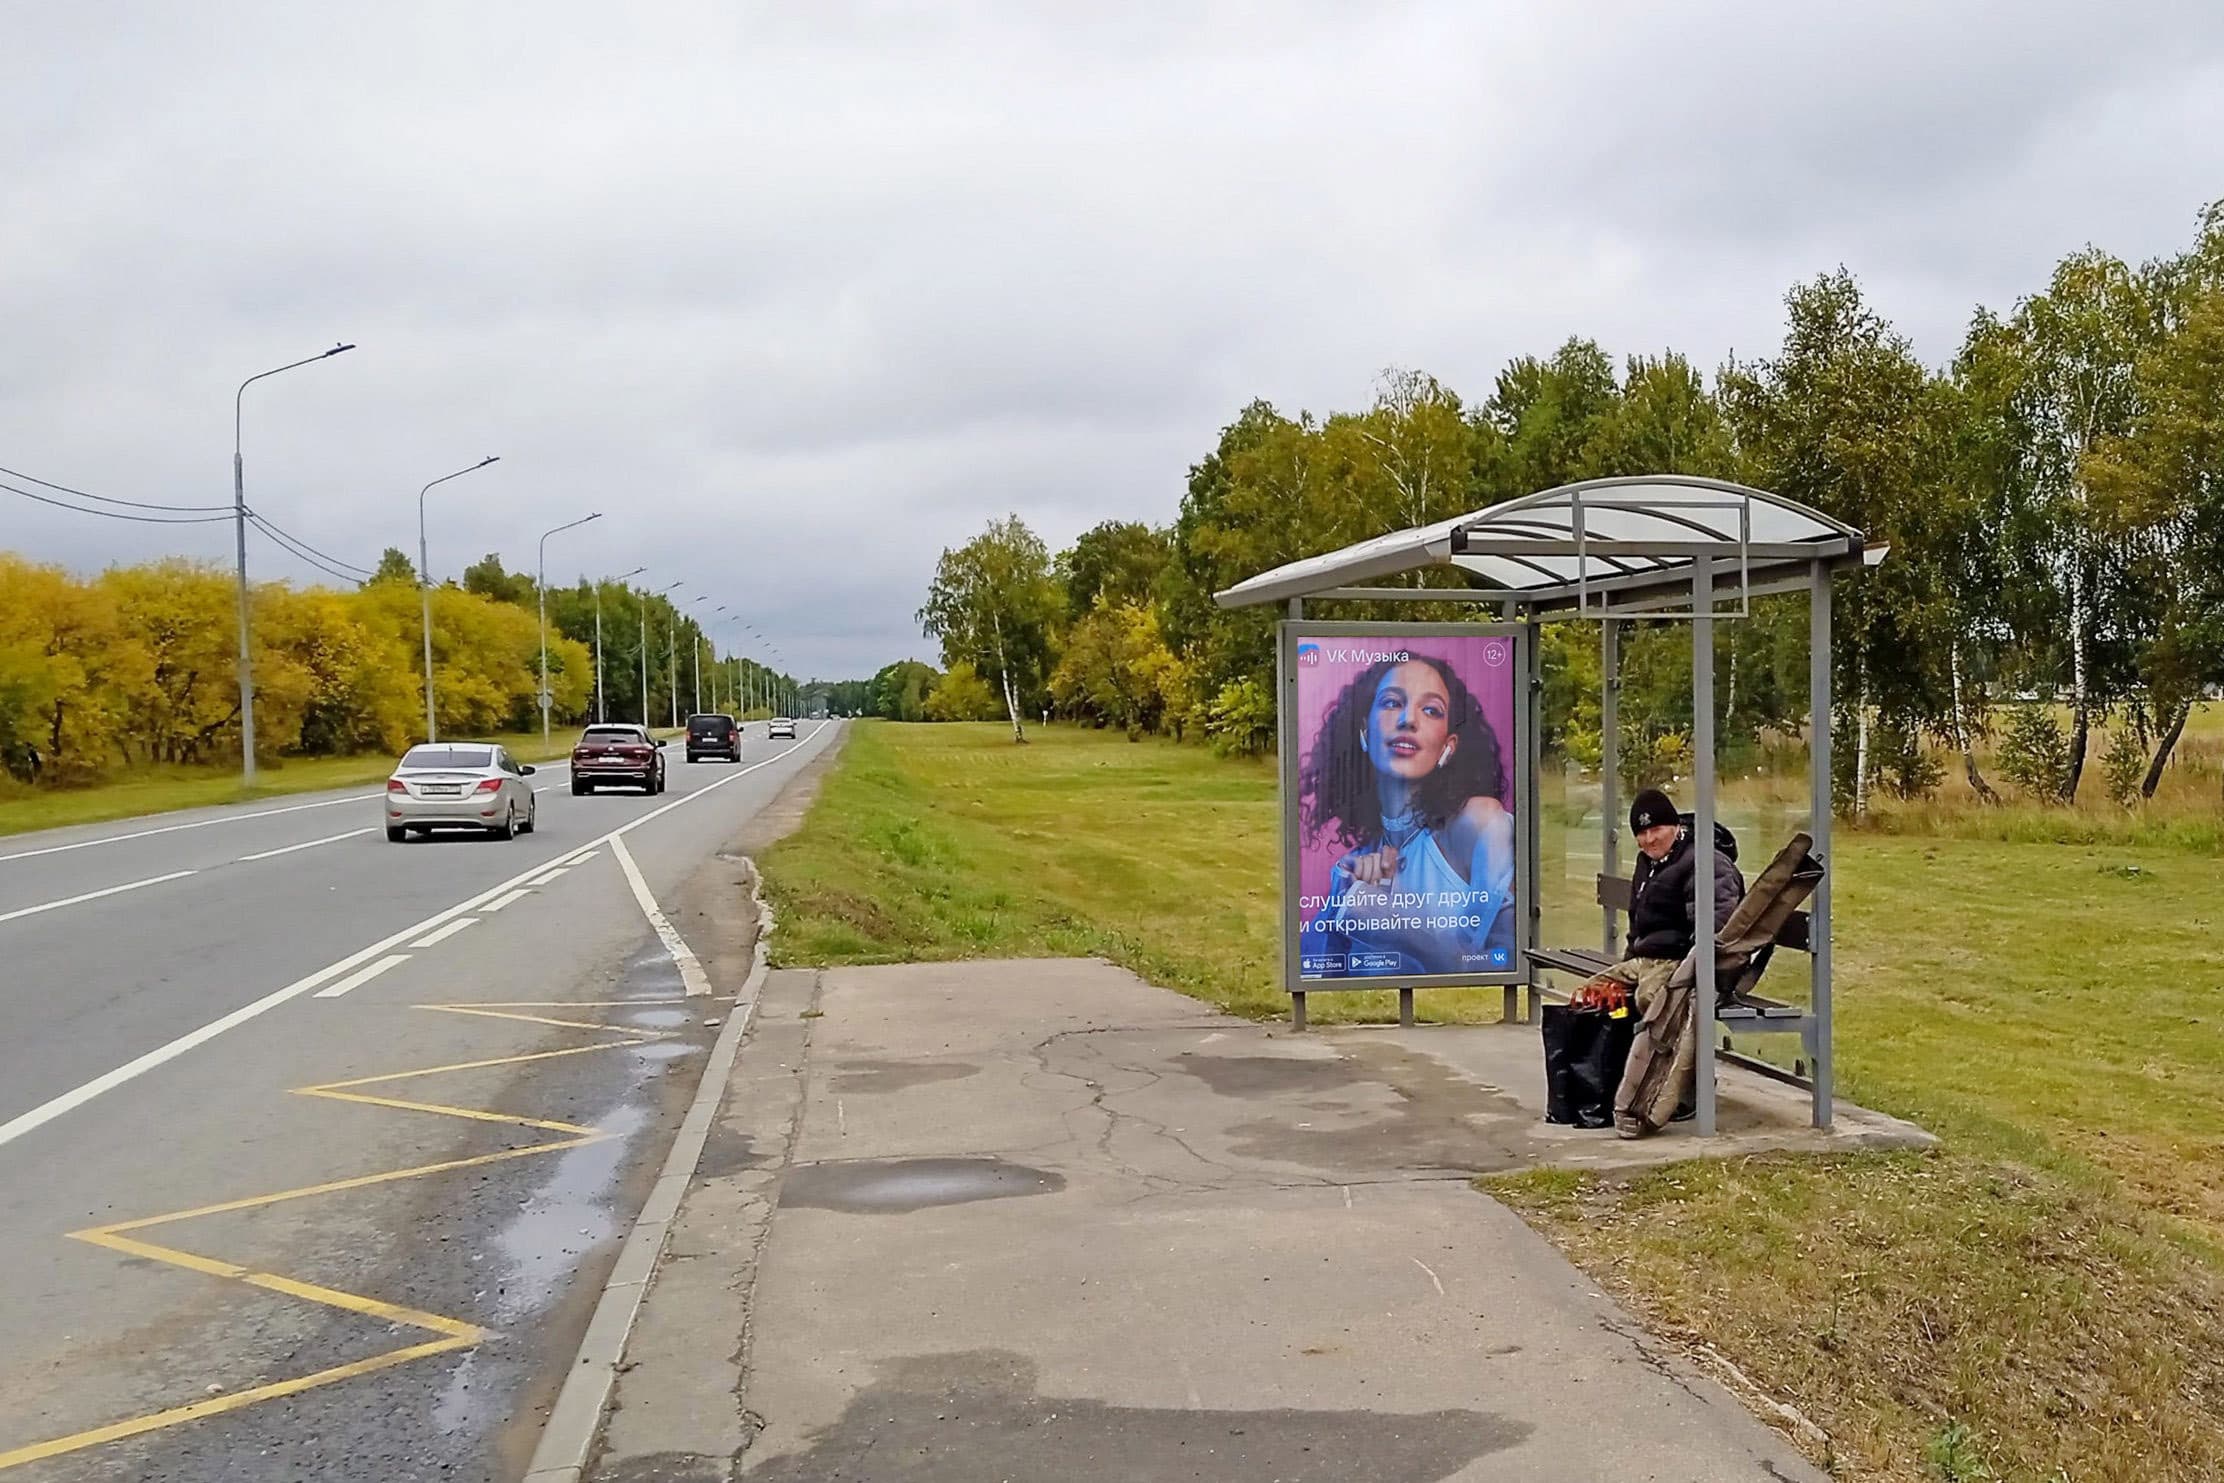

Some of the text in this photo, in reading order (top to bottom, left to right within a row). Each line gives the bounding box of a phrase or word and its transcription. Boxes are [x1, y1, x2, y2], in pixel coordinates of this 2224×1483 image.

[1325, 649, 1409, 666] VK Музыка
[1487, 650, 1503, 660] 12+
[1300, 890, 1489, 911] слушайте друг друга
[1300, 914, 1481, 935] и открывайте новое
[1363, 958, 1398, 968] Google Play
[1461, 954, 1489, 963] проект
[1312, 961, 1326, 969] App
